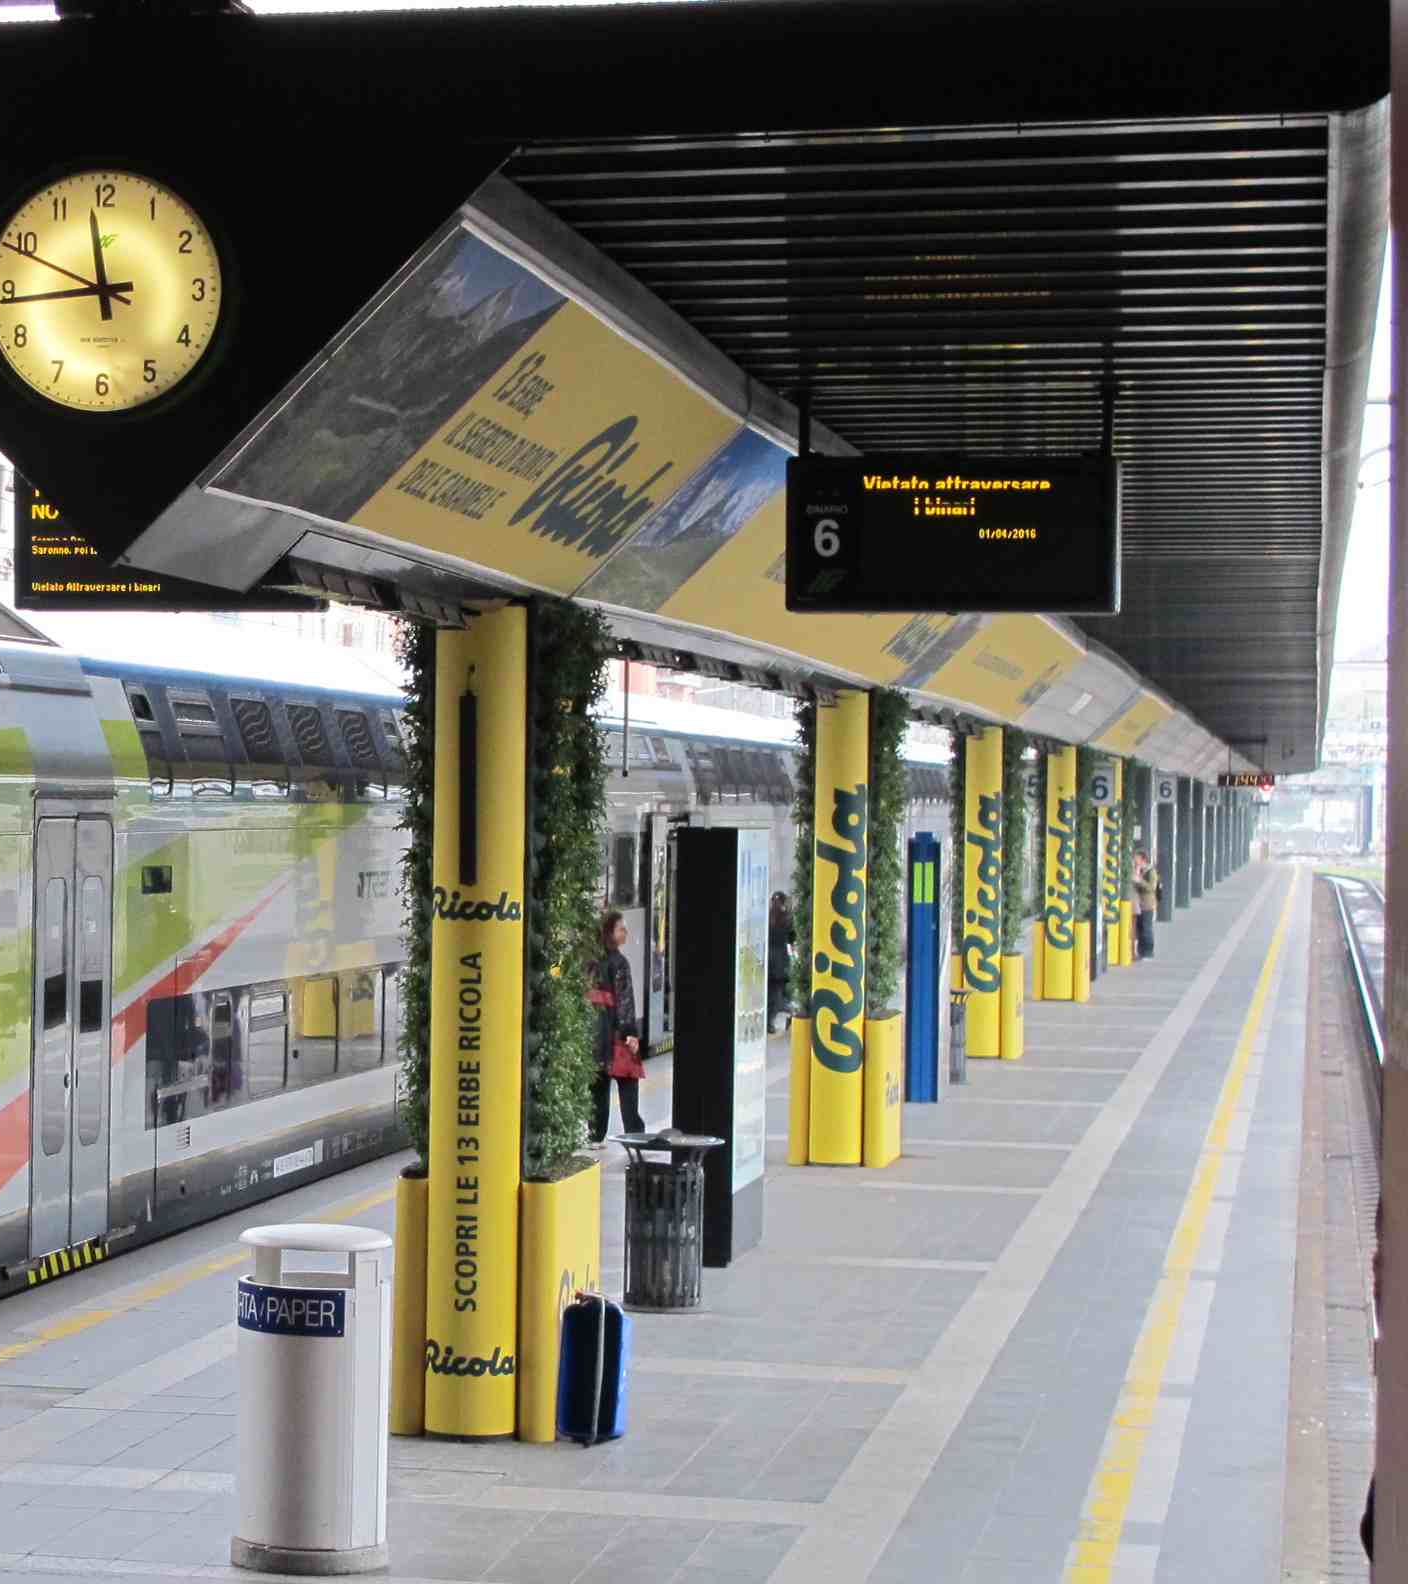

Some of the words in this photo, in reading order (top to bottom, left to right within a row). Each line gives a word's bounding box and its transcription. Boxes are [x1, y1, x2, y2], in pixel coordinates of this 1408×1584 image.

[95, 184, 116, 208] 12
[53, 197, 67, 222] 11
[149, 197, 156, 221] 1
[16, 232, 38, 255] 10
[178, 230, 193, 253] 2
[1, 280, 16, 301] 9
[192, 279, 205, 302] 3
[13, 324, 28, 348] 8
[176, 324, 192, 347] 4
[51, 360, 65, 383] 7
[143, 360, 157, 383] 5
[95, 374, 109, 396] 6
[813, 519, 840, 558] 6
[978, 528, 1037, 540] 01/04/2016
[1092, 775, 1109, 801] 6
[1159, 780, 1172, 799] 6
[1045, 796, 1077, 950] Ricola
[432, 885, 522, 922] Ricola
[962, 792, 1003, 993] Ricola
[810, 783, 868, 1074] Ricola
[458, 952, 483, 1051] RICOLA
[457, 1060, 481, 1126] ERBE
[457, 1137, 480, 1166] 13
[456, 1176, 480, 1206] LE
[455, 1215, 478, 1313] SCOPRI
[266, 1296, 336, 1328] PAPER
[425, 1338, 515, 1377] Ricola
